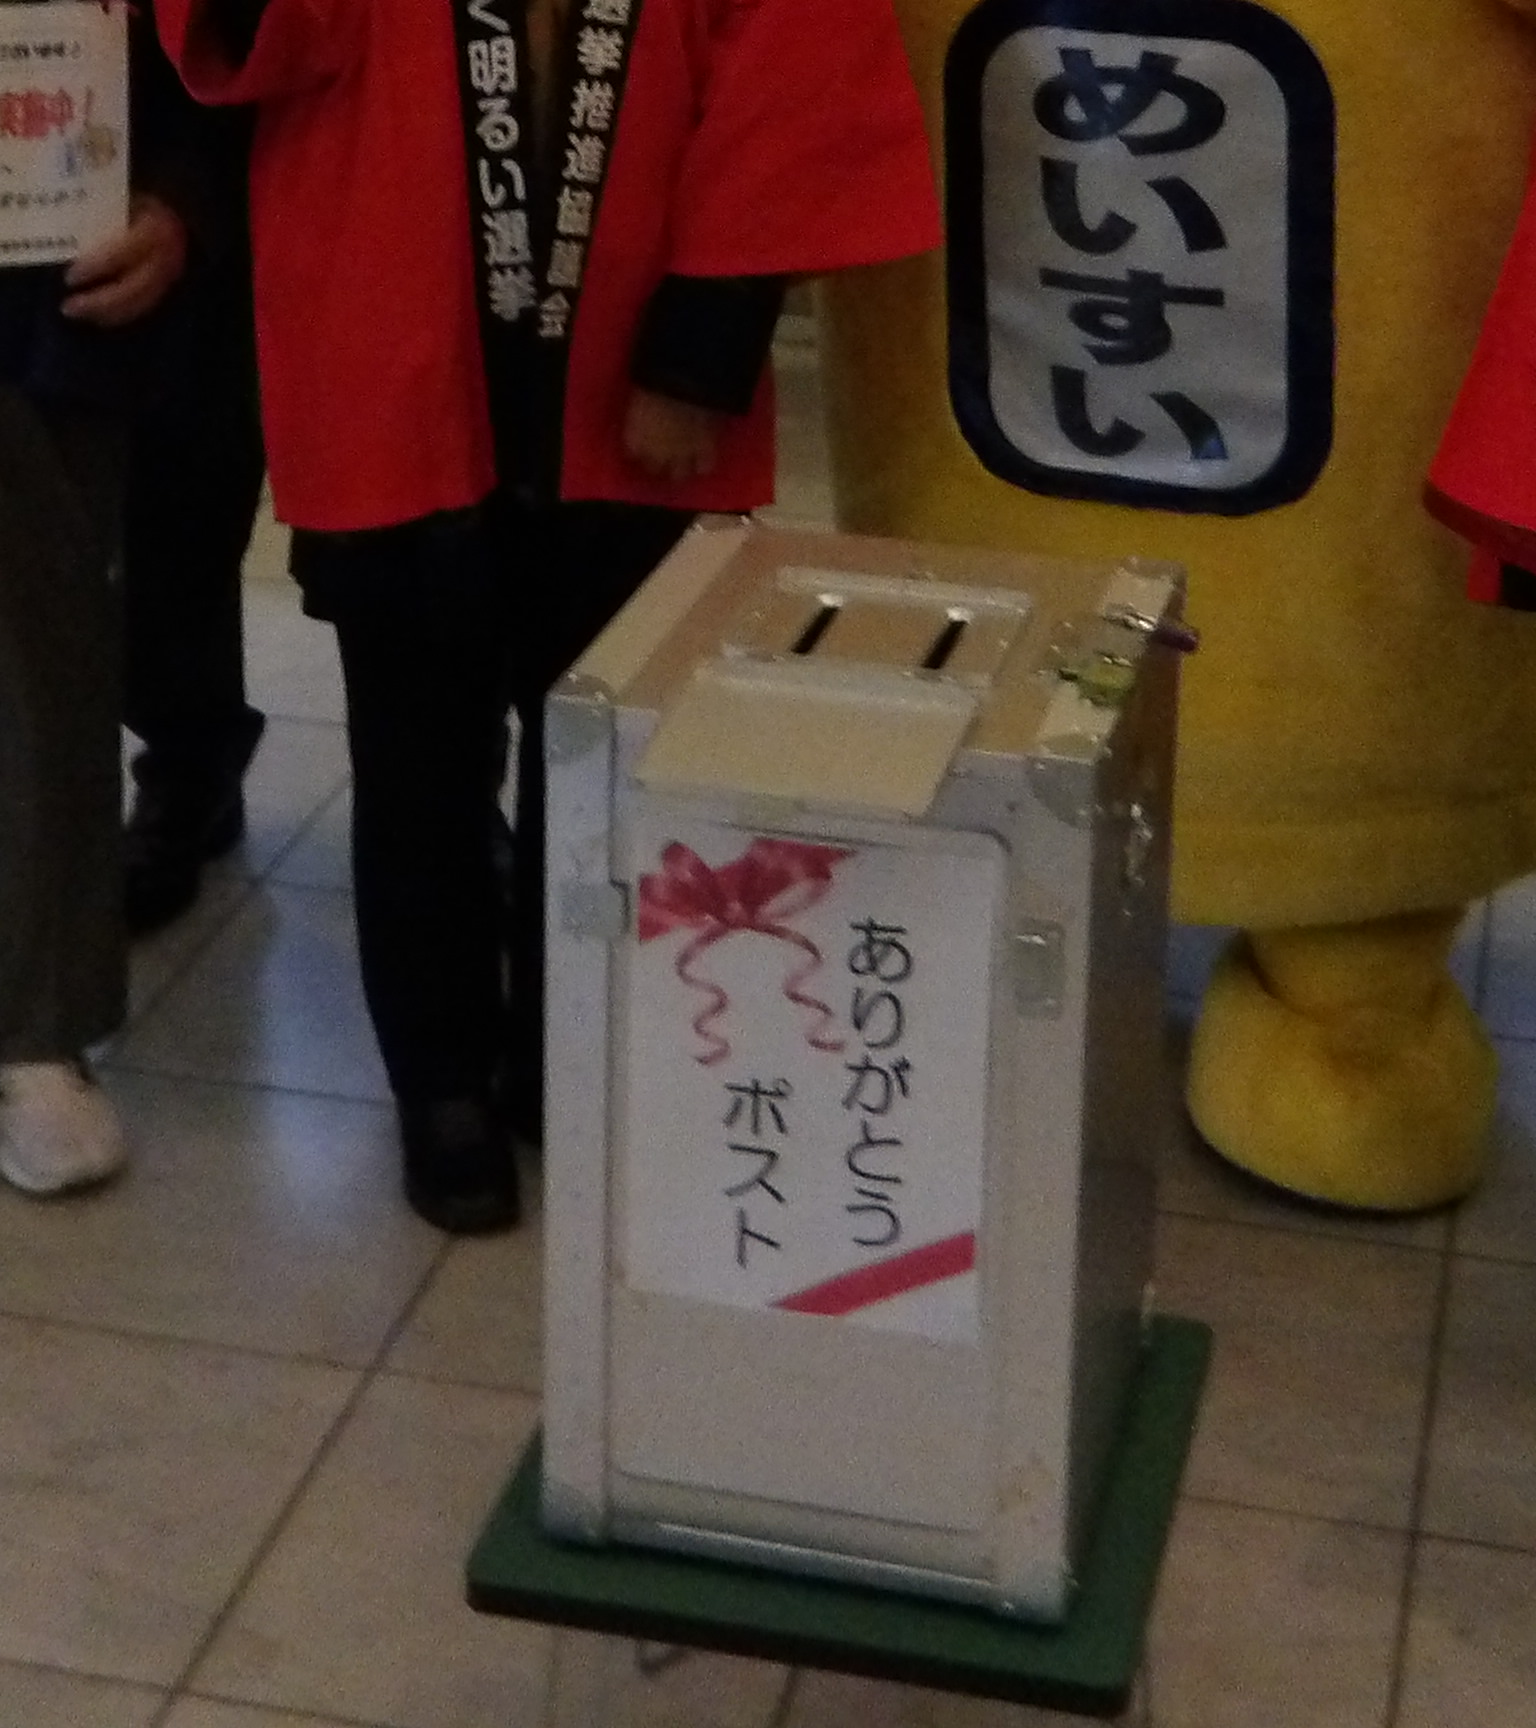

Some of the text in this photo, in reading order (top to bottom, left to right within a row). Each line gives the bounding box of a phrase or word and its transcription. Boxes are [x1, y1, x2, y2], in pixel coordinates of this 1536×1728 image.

[1032, 46, 1229, 461] めいすい
[722, 1076, 795, 1270] ポスト
[842, 916, 914, 1248] ありがとう
